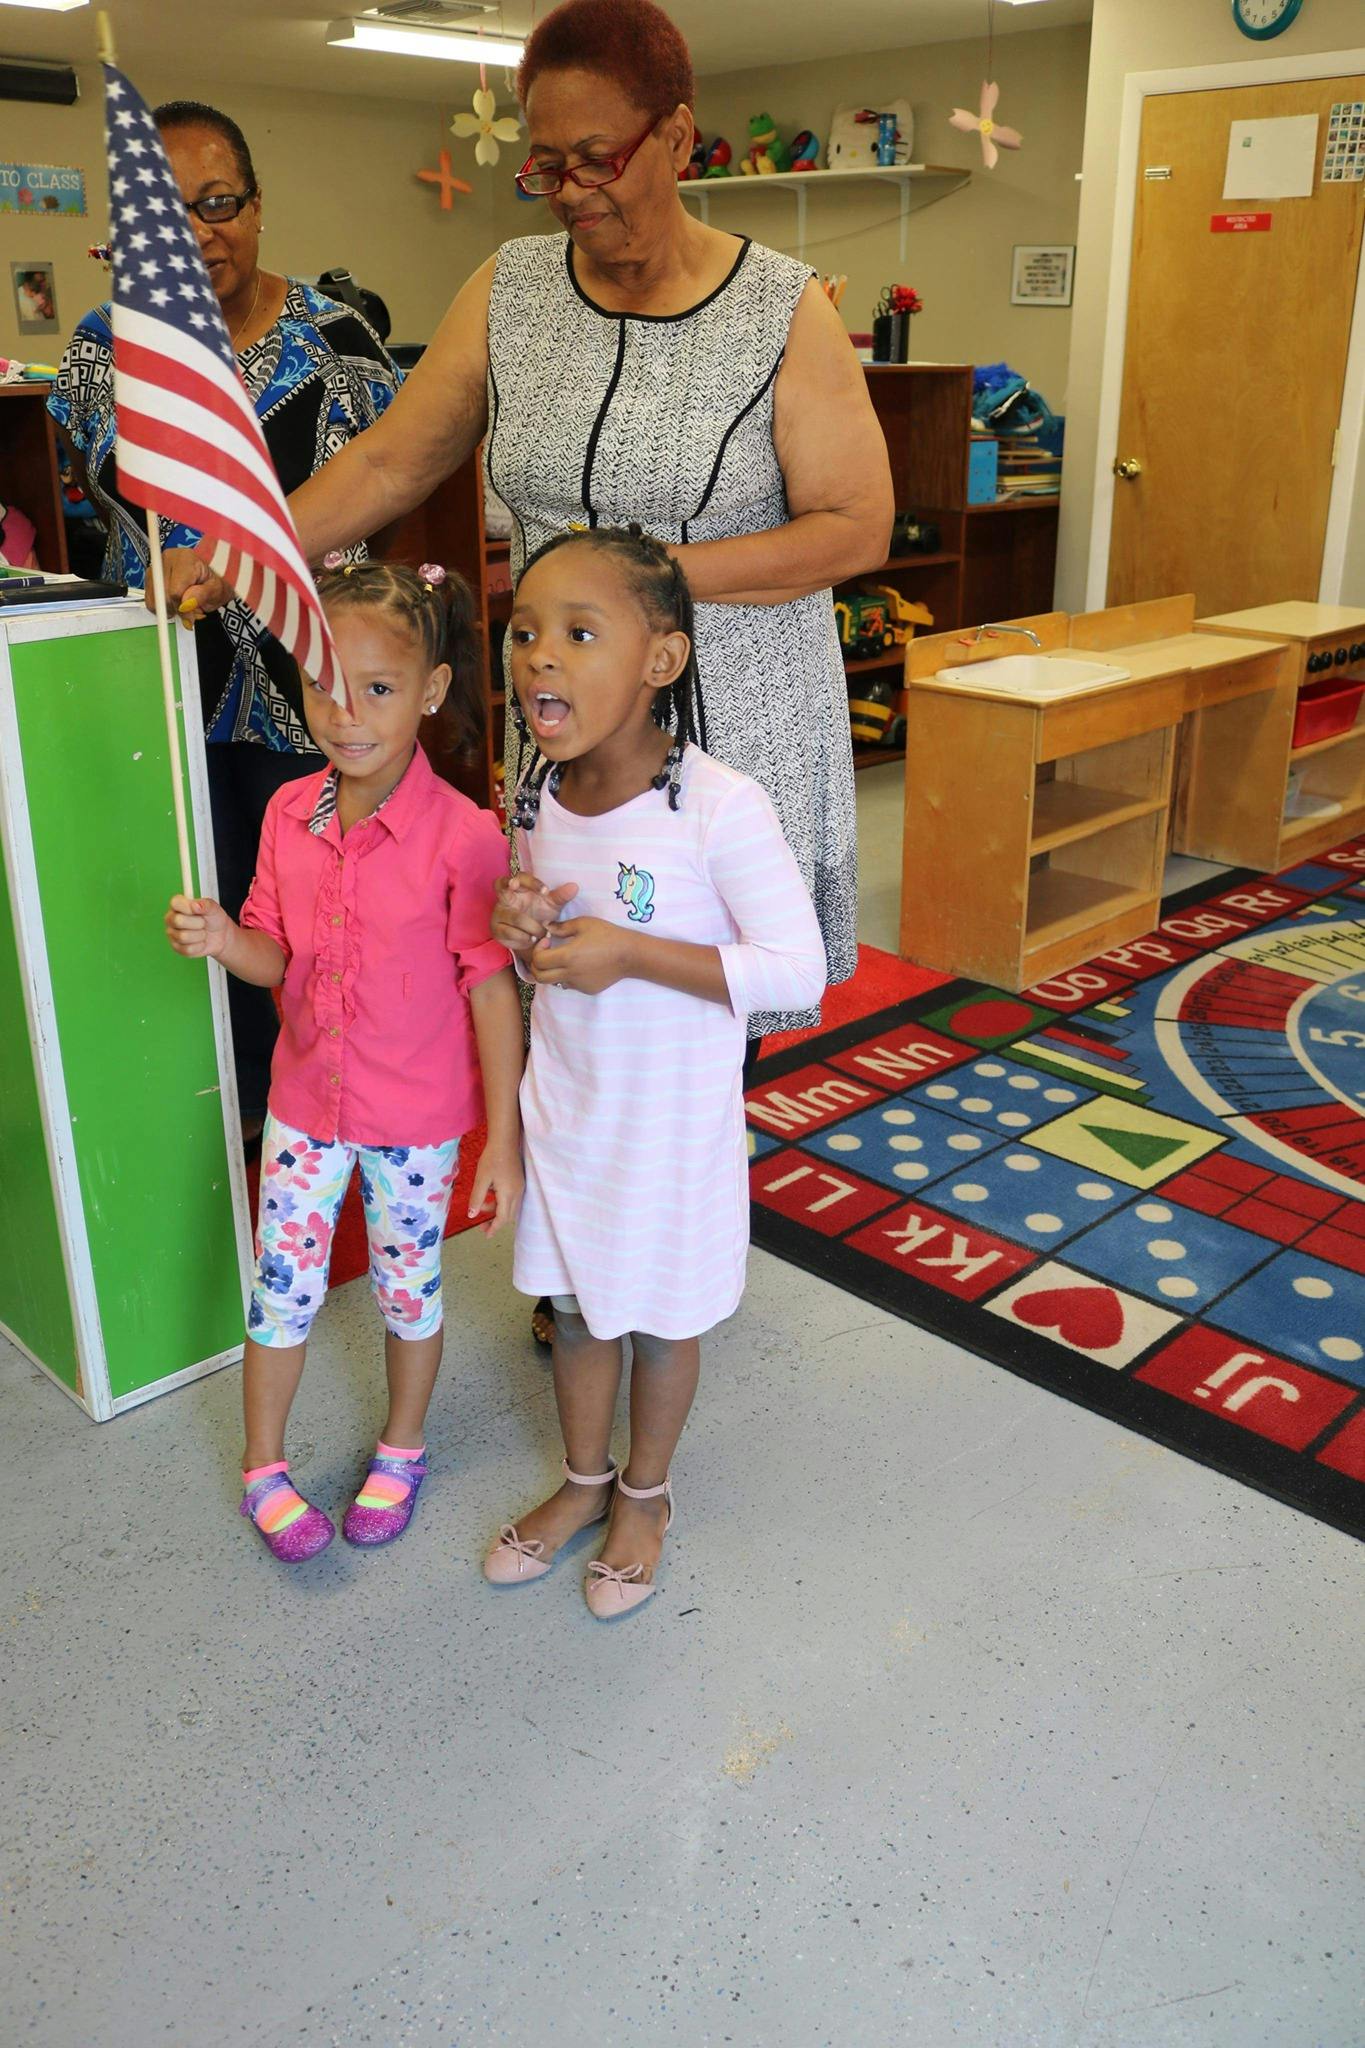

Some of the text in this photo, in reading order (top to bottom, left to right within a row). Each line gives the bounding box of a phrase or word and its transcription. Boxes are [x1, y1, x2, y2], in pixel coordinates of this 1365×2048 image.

[0, 170, 80, 191] TO CLASS
[1328, 848, 1365, 869] S
[1221, 889, 1292, 914] Rr
[1161, 914, 1249, 939] Qq
[1101, 941, 1178, 969] Pp
[1030, 972, 1108, 1002] Oo
[1309, 1028, 1365, 1048] 5
[853, 1042, 954, 1080] Nn
[1217, 1077, 1245, 1092] 22
[744, 1080, 871, 1131] Mm
[1233, 1098, 1262, 1111] 21
[1259, 1116, 1291, 1132] 20
[882, 1214, 1004, 1282] Kk
[1193, 1352, 1301, 1412] Jj
